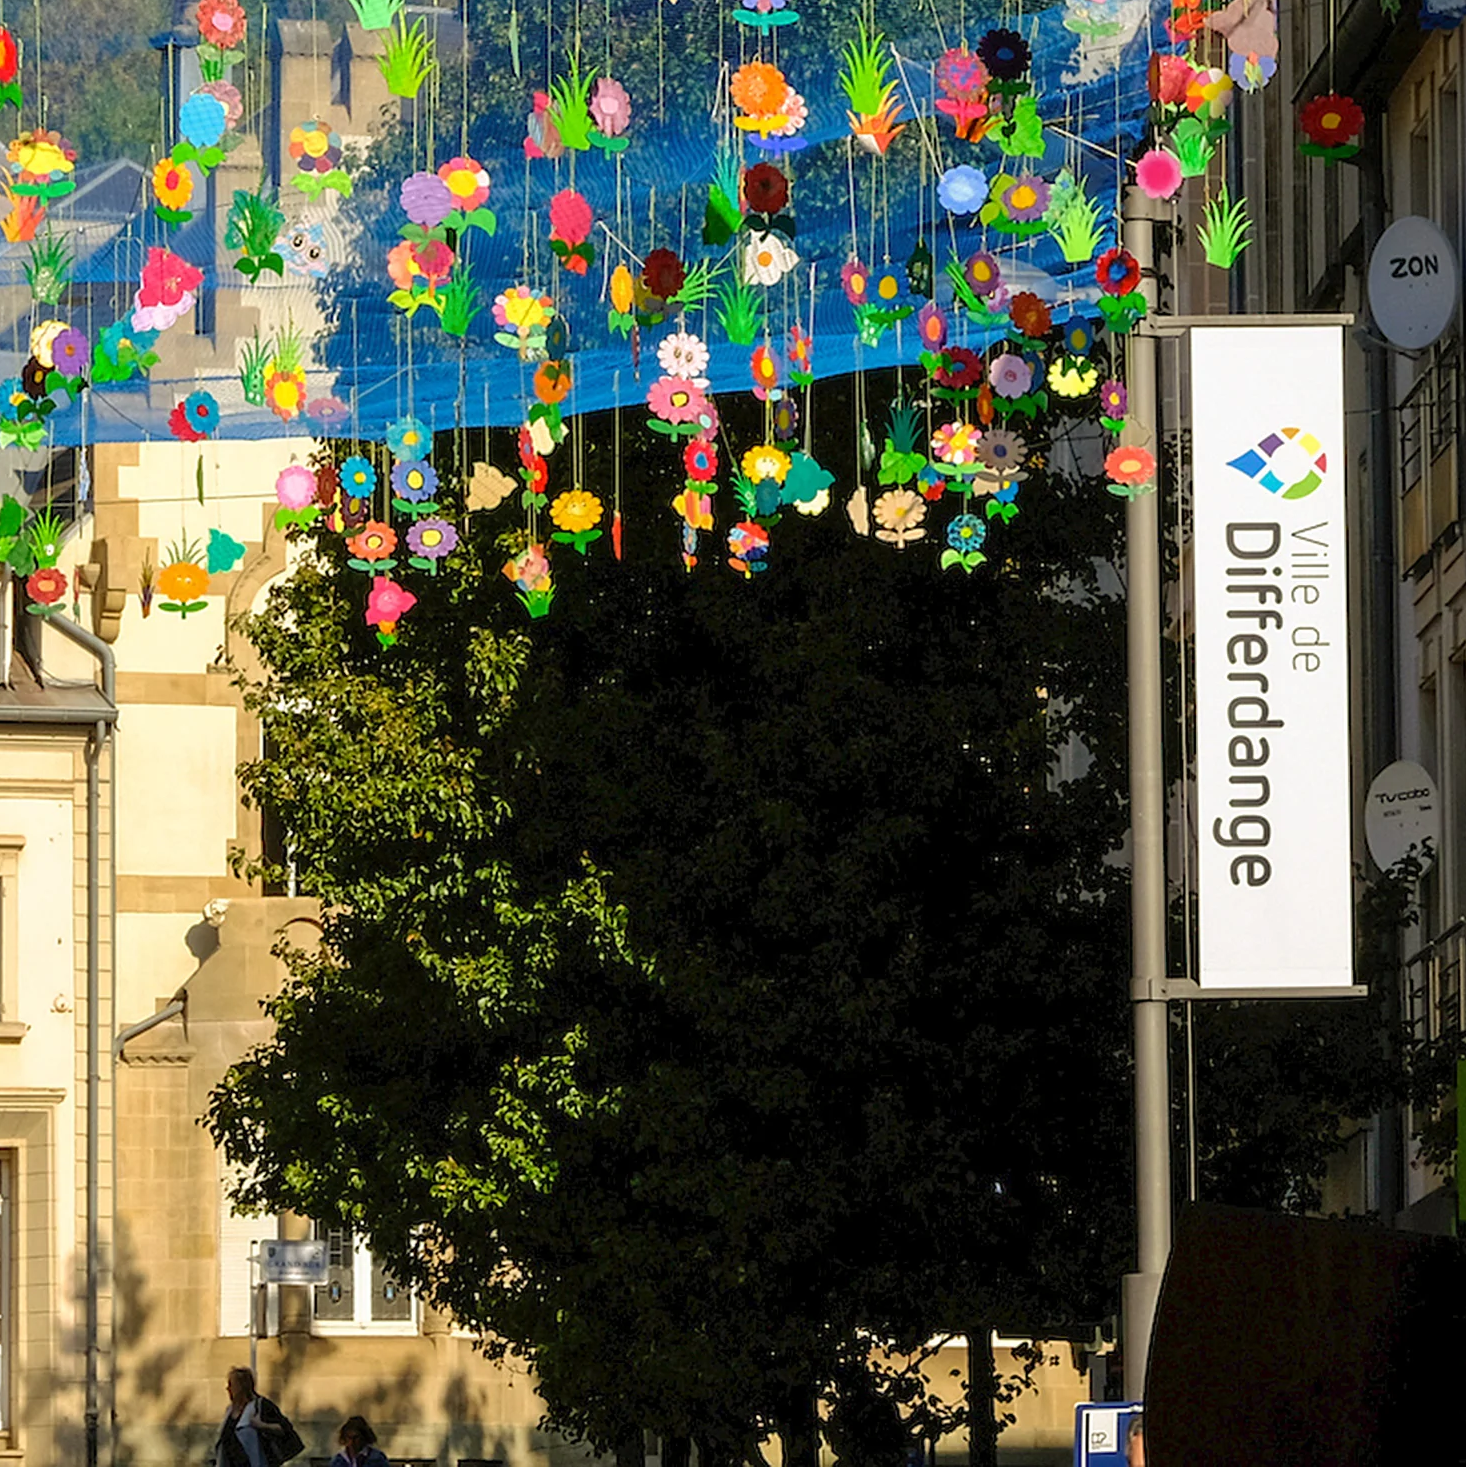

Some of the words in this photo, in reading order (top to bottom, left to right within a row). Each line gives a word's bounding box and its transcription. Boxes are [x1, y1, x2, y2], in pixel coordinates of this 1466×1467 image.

[1390, 255, 1439, 279] ZON
[1290, 521, 1330, 605] Ville
[1291, 626, 1330, 673] de
[1212, 521, 1285, 888] Differdange
